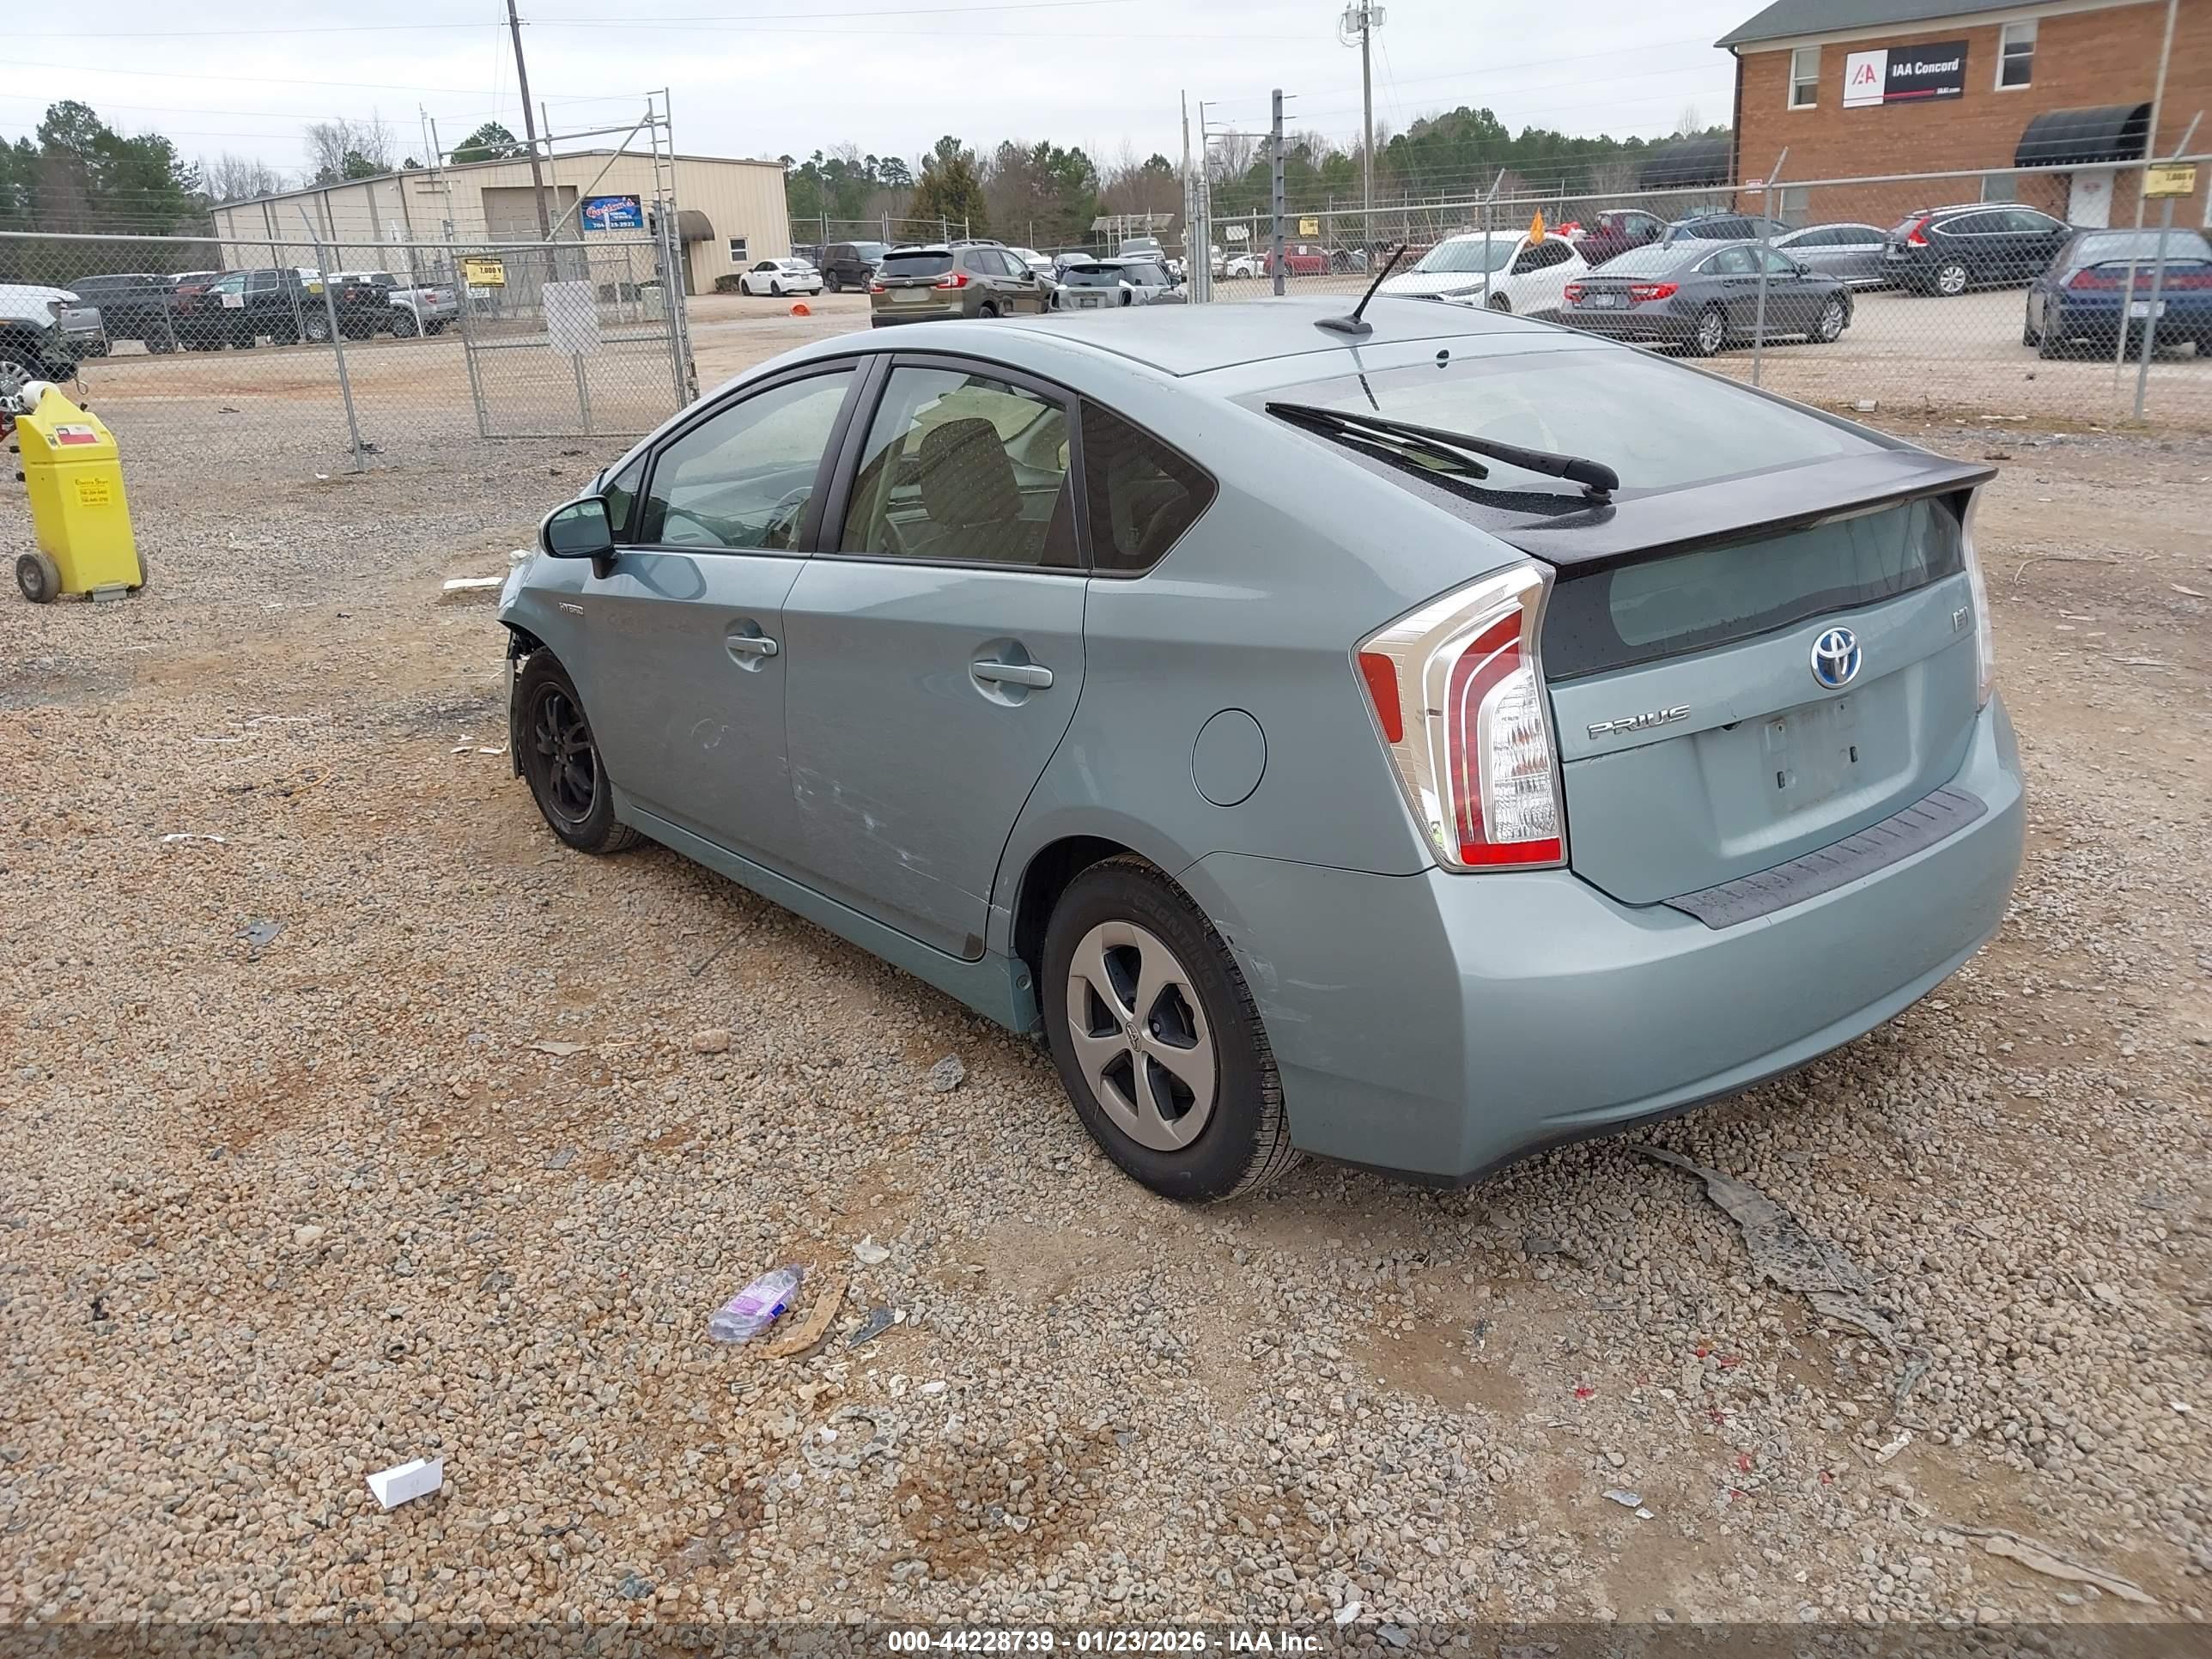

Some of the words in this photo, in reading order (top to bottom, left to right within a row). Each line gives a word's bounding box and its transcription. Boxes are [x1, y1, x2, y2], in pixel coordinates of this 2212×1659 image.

[1892, 63, 1912, 77] IAA
[1914, 57, 1960, 75] Concord
[480, 266, 496, 275] 7,000
[1587, 704, 1691, 740] PRIUS
